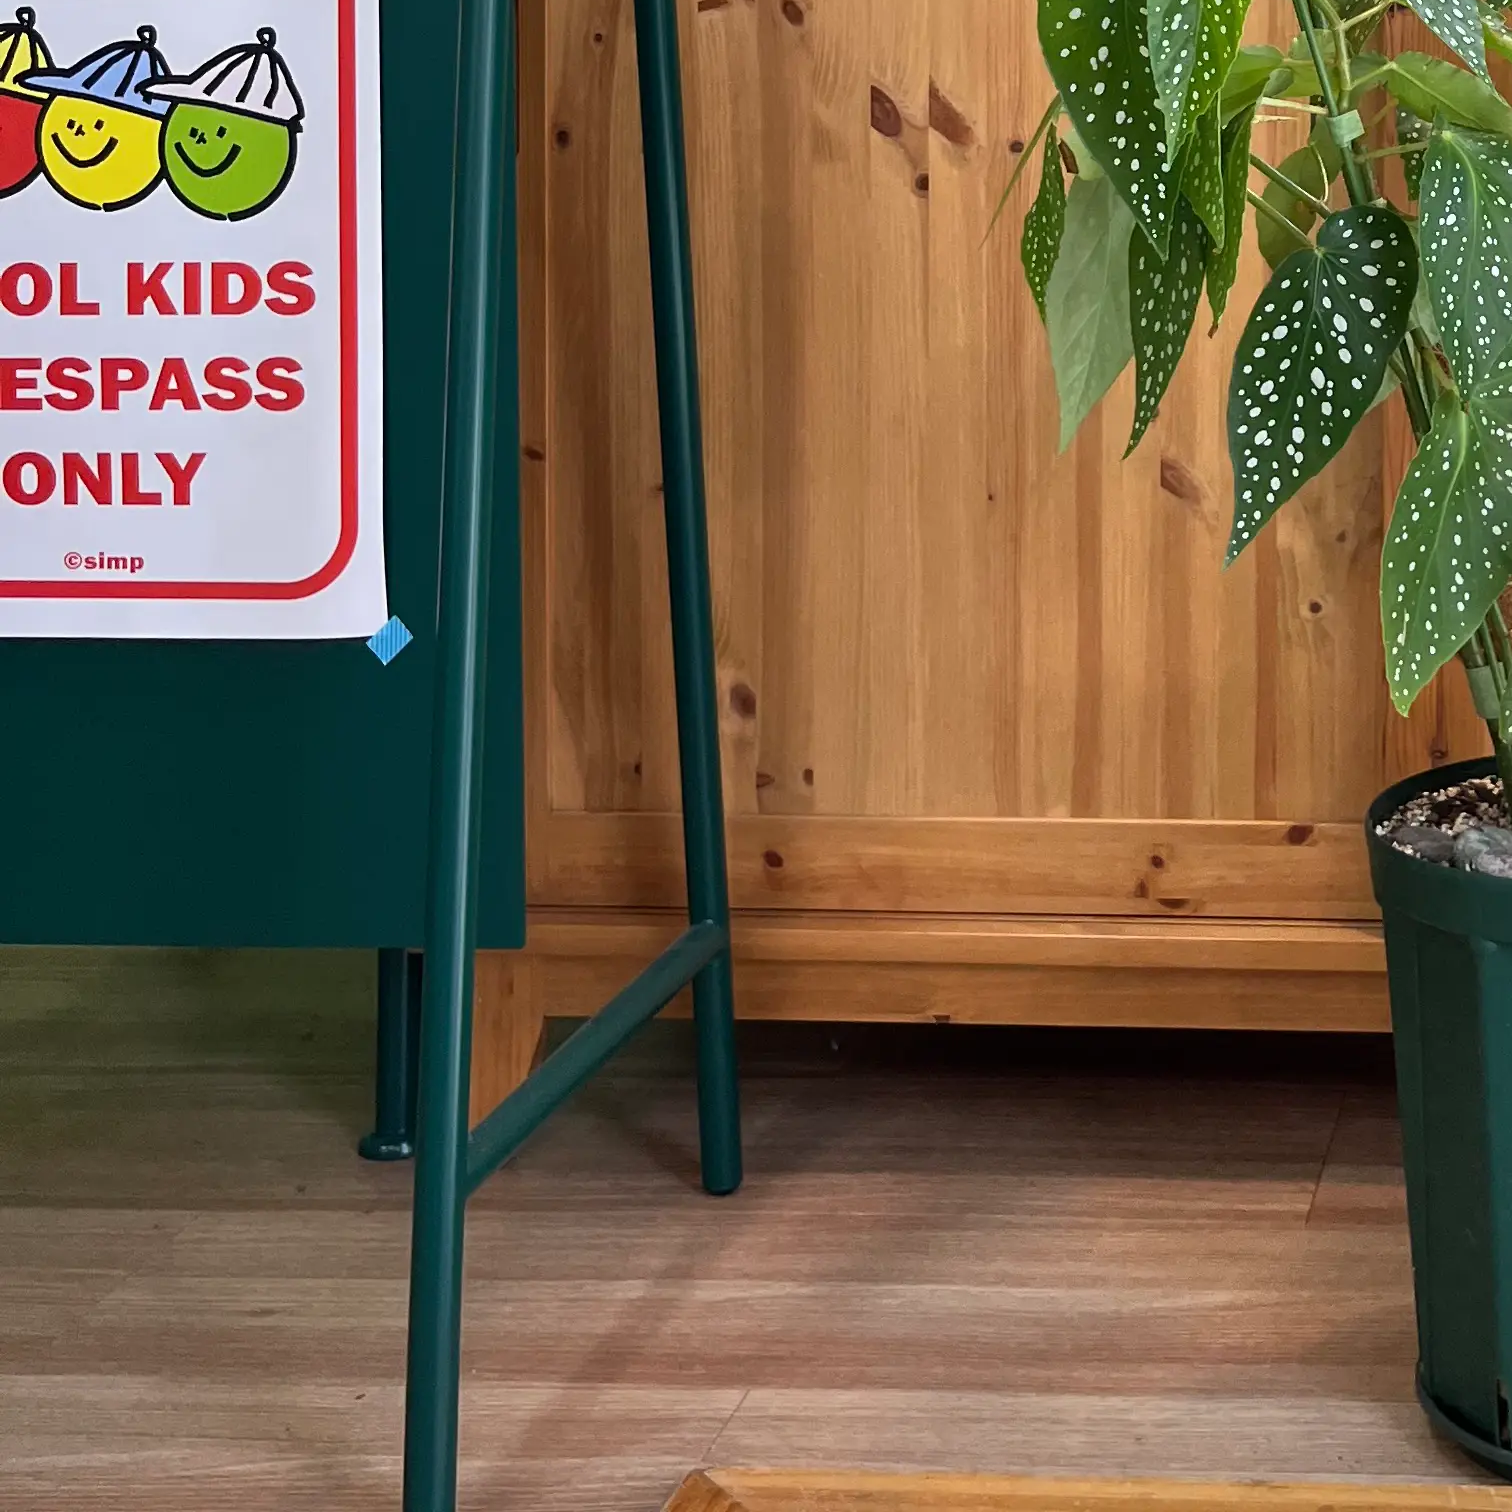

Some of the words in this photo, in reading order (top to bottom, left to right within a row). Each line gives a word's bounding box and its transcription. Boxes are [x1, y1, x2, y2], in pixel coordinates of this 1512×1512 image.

[0, 262, 100, 317] OL
[126, 261, 316, 316] KIDS
[0, 356, 305, 412] ESPASS
[2, 451, 206, 506] ONLY
